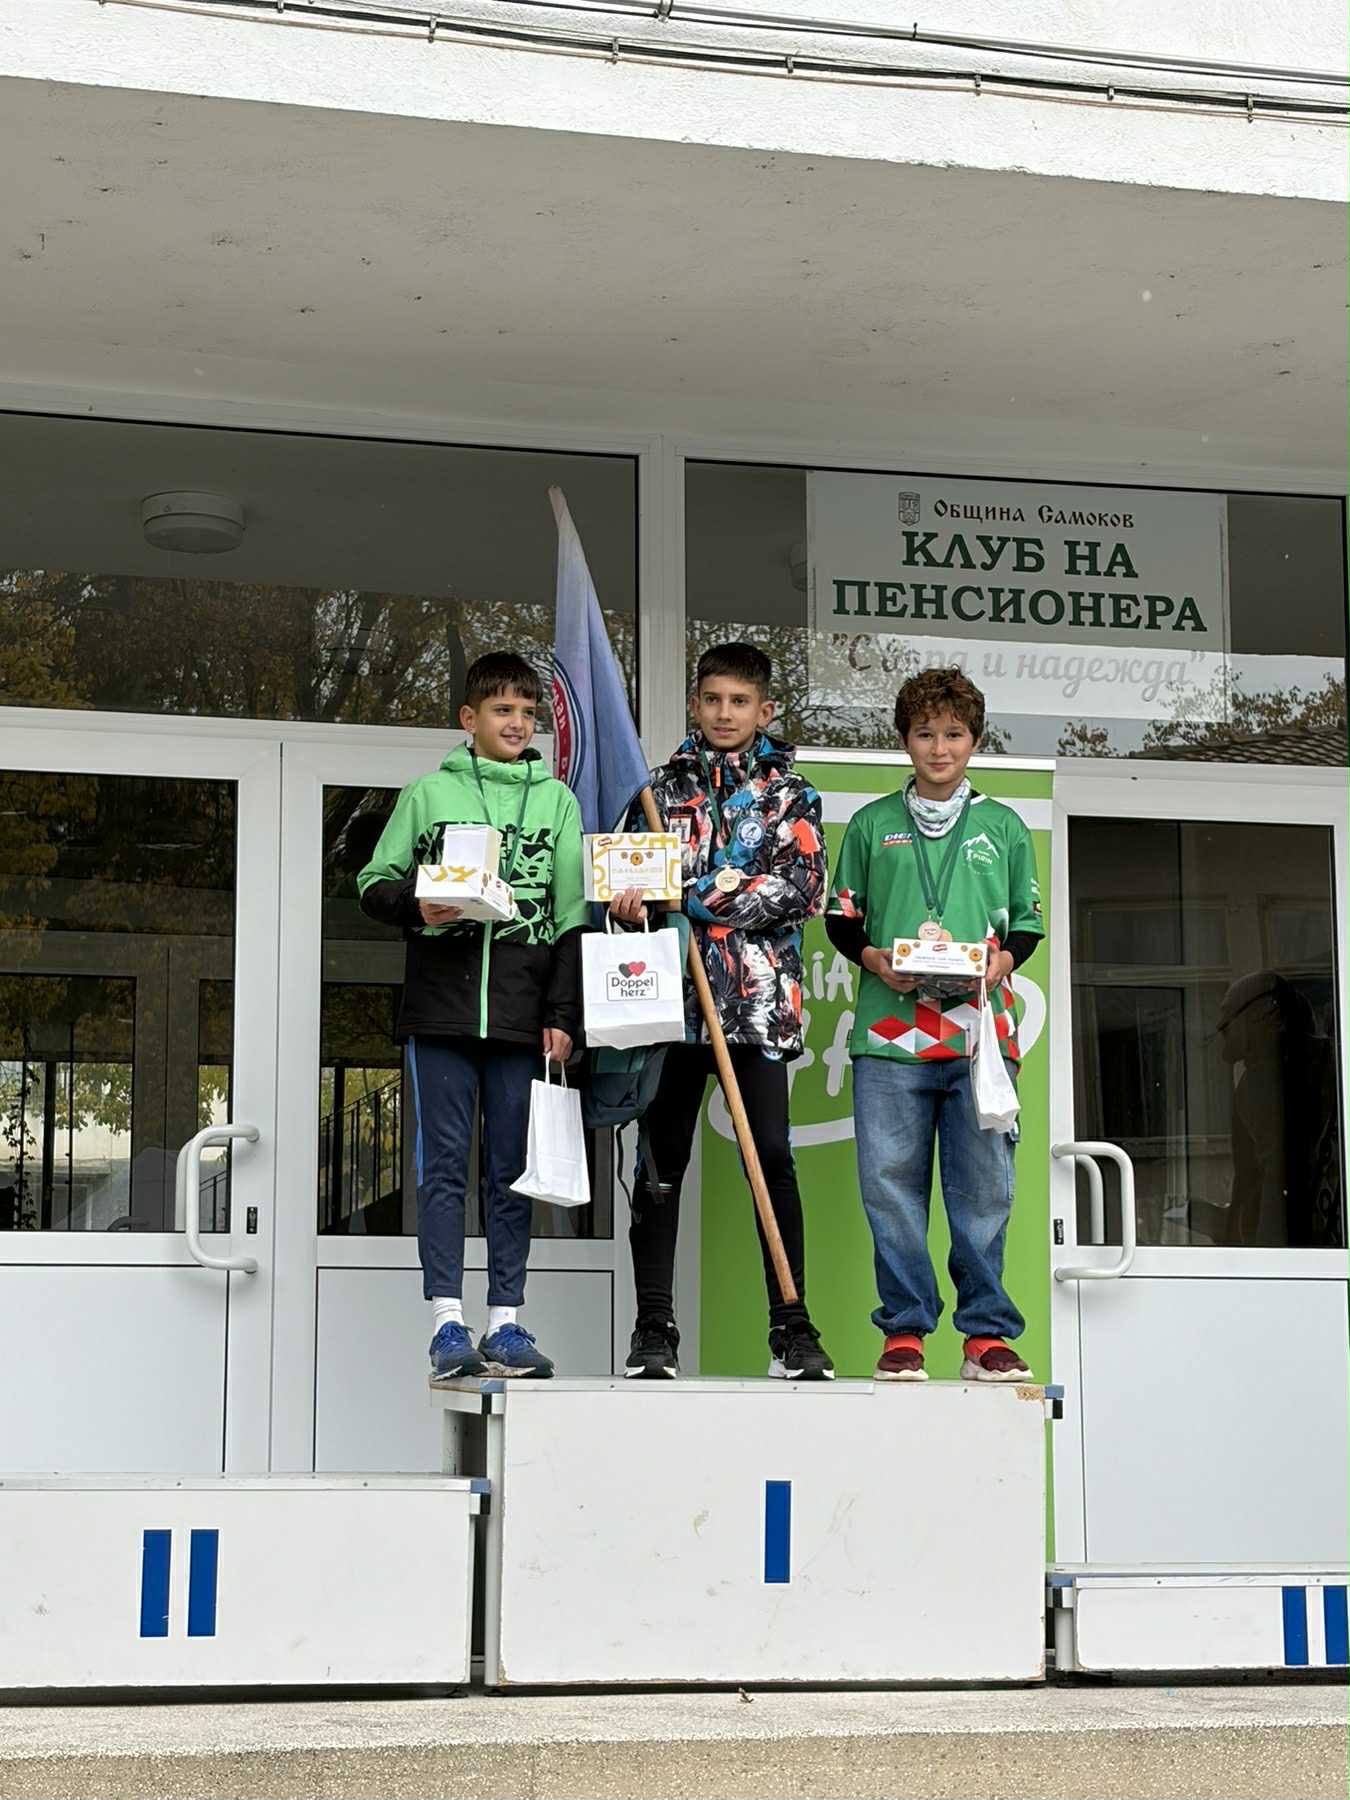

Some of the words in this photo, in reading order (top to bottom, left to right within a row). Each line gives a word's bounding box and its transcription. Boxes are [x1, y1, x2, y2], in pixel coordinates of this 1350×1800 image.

[901, 530, 1045, 574] КЛУБ
[1064, 539, 1139, 579] НА
[832, 579, 1208, 632] ПЕНСИОНЕРА
[983, 652, 1007, 677] и
[611, 977, 654, 989] Doppel
